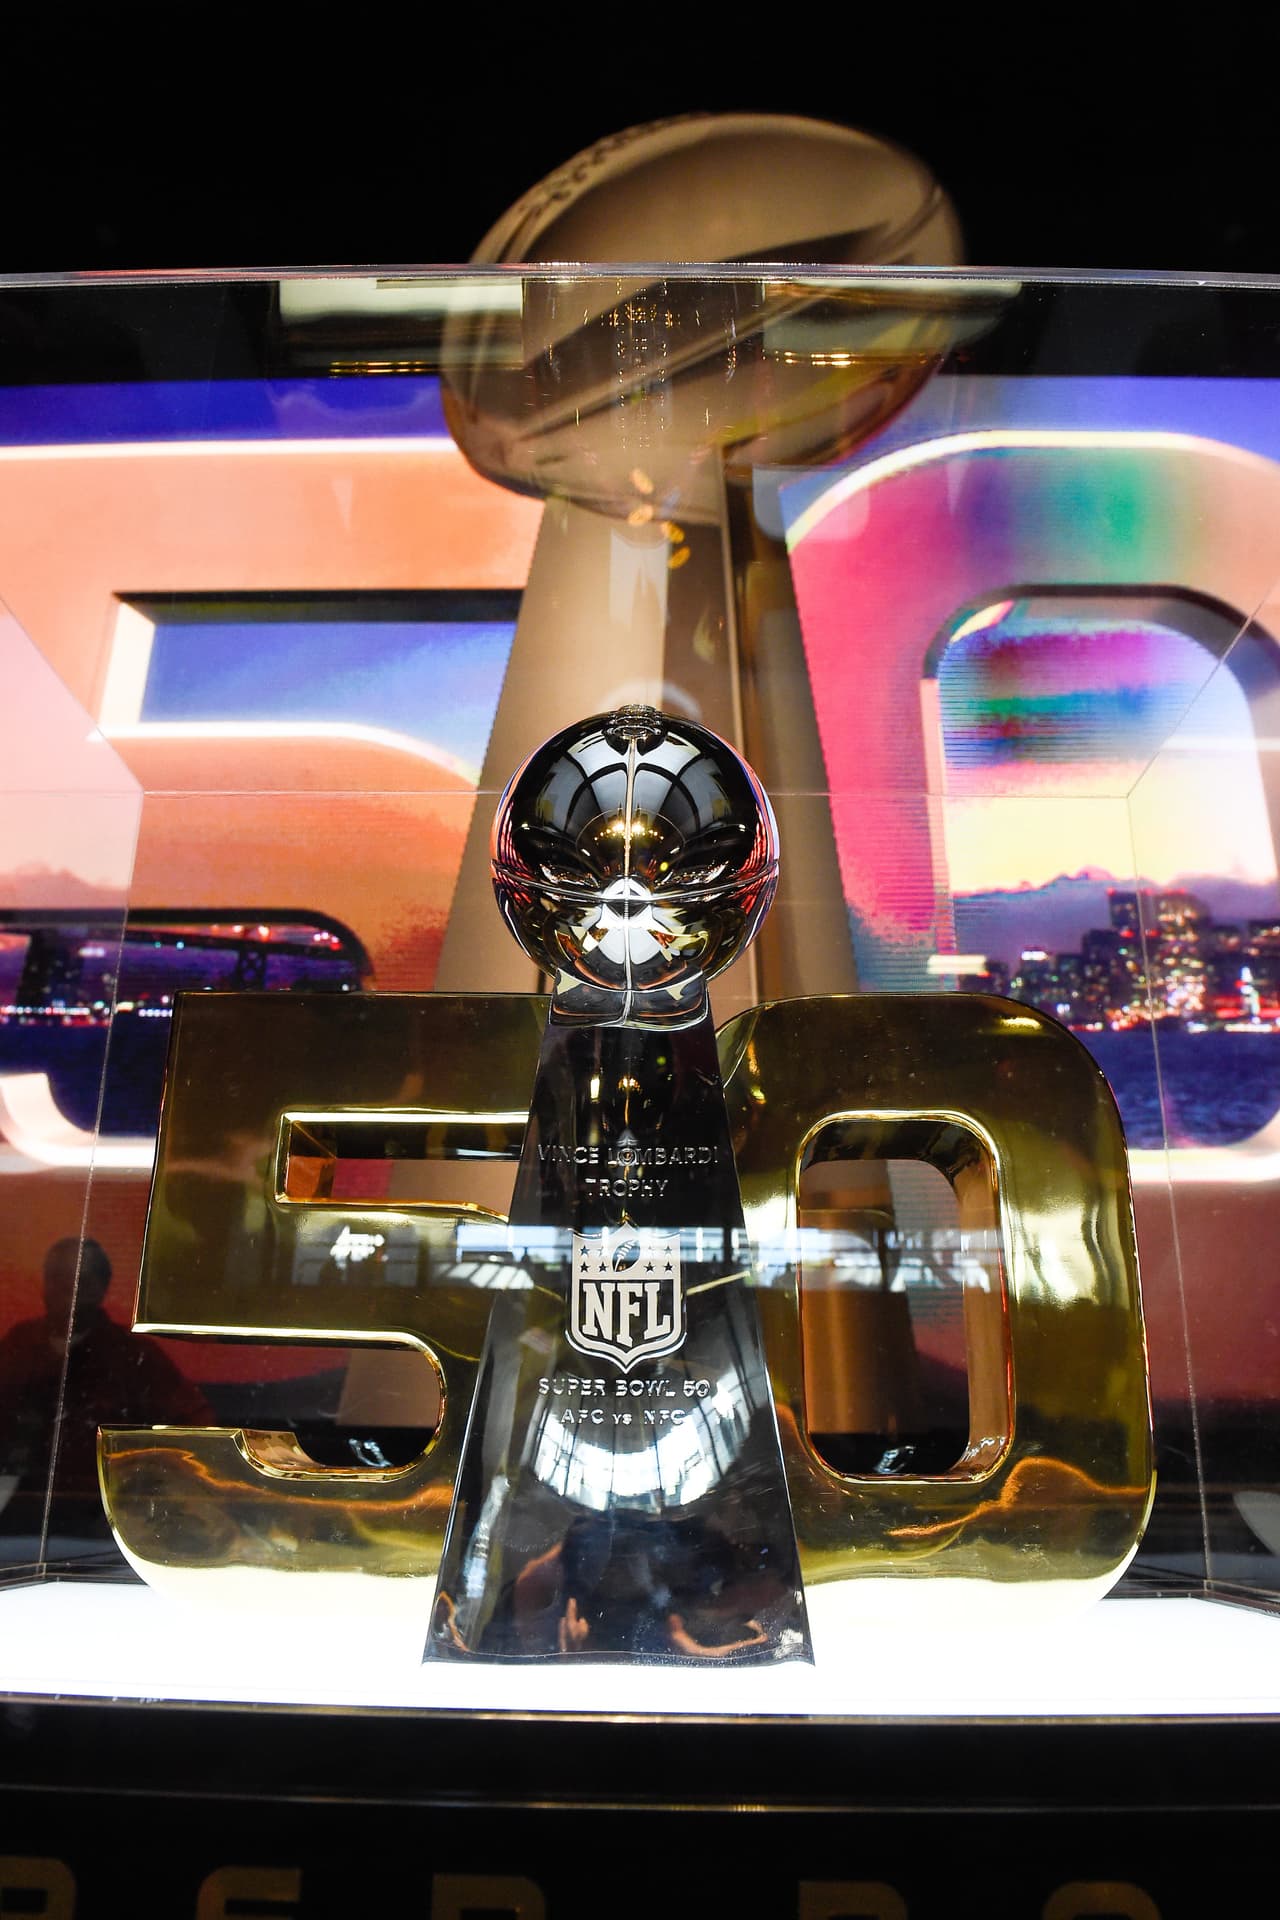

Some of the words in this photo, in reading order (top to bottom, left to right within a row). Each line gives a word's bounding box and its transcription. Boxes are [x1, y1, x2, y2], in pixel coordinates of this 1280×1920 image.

[537, 1143, 599, 1165] VINCE
[607, 1145, 719, 1166] LOMBARDI
[585, 1177, 669, 1197] TROPHY
[582, 1281, 671, 1348] NFL
[538, 1377, 607, 1397] SUPER
[615, 1379, 676, 1397] BOWL
[682, 1379, 711, 1397] 50
[561, 1408, 605, 1425] AFC
[643, 1408, 687, 1425] NFC
